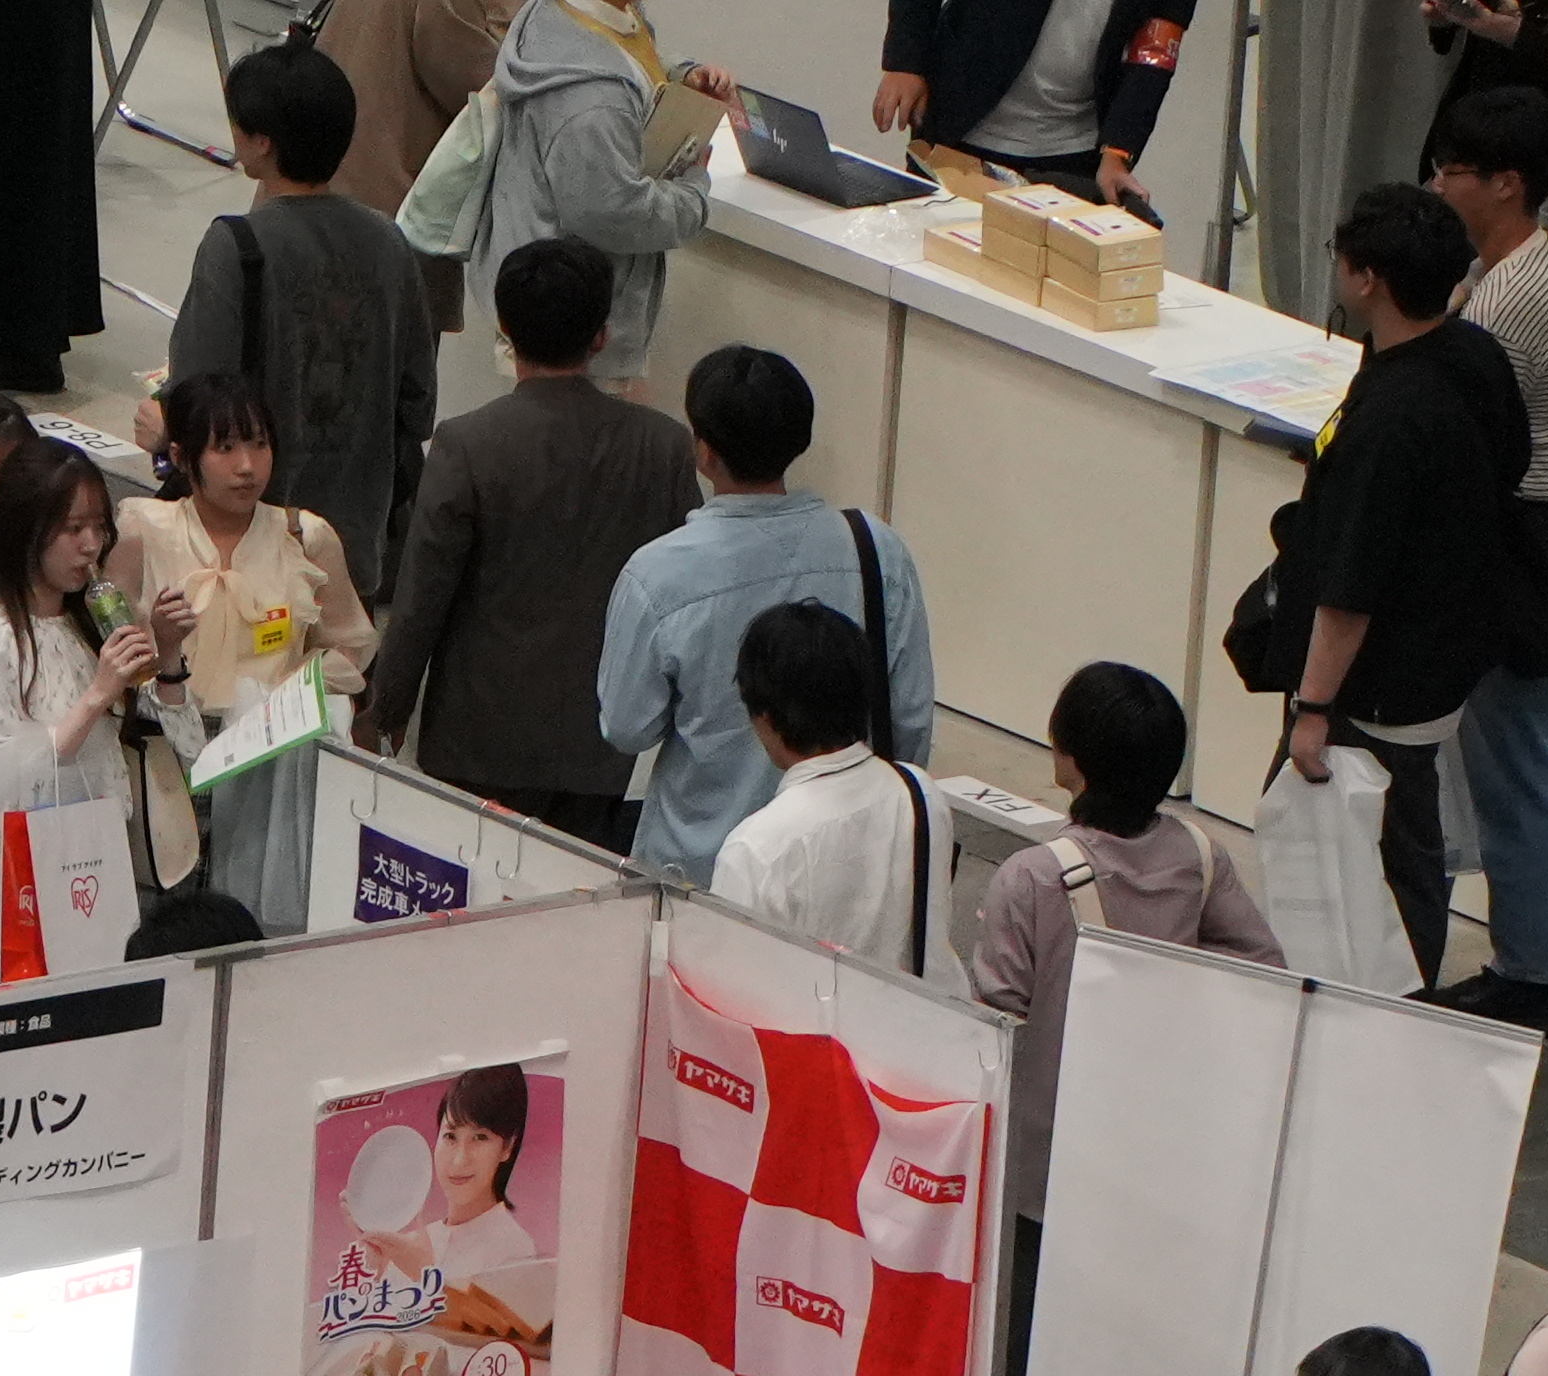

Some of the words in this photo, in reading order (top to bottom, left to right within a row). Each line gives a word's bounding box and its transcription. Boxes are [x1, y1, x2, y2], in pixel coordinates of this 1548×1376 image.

[38, 419, 124, 452] P8-6
[372, 852, 455, 905] 大型トラック
[683, 1053, 751, 1104] ヤマザキ
[907, 1169, 964, 1200] ヤマザキ
[66, 1266, 134, 1302] ヤマザキ
[322, 1267, 441, 1323] パンまつり
